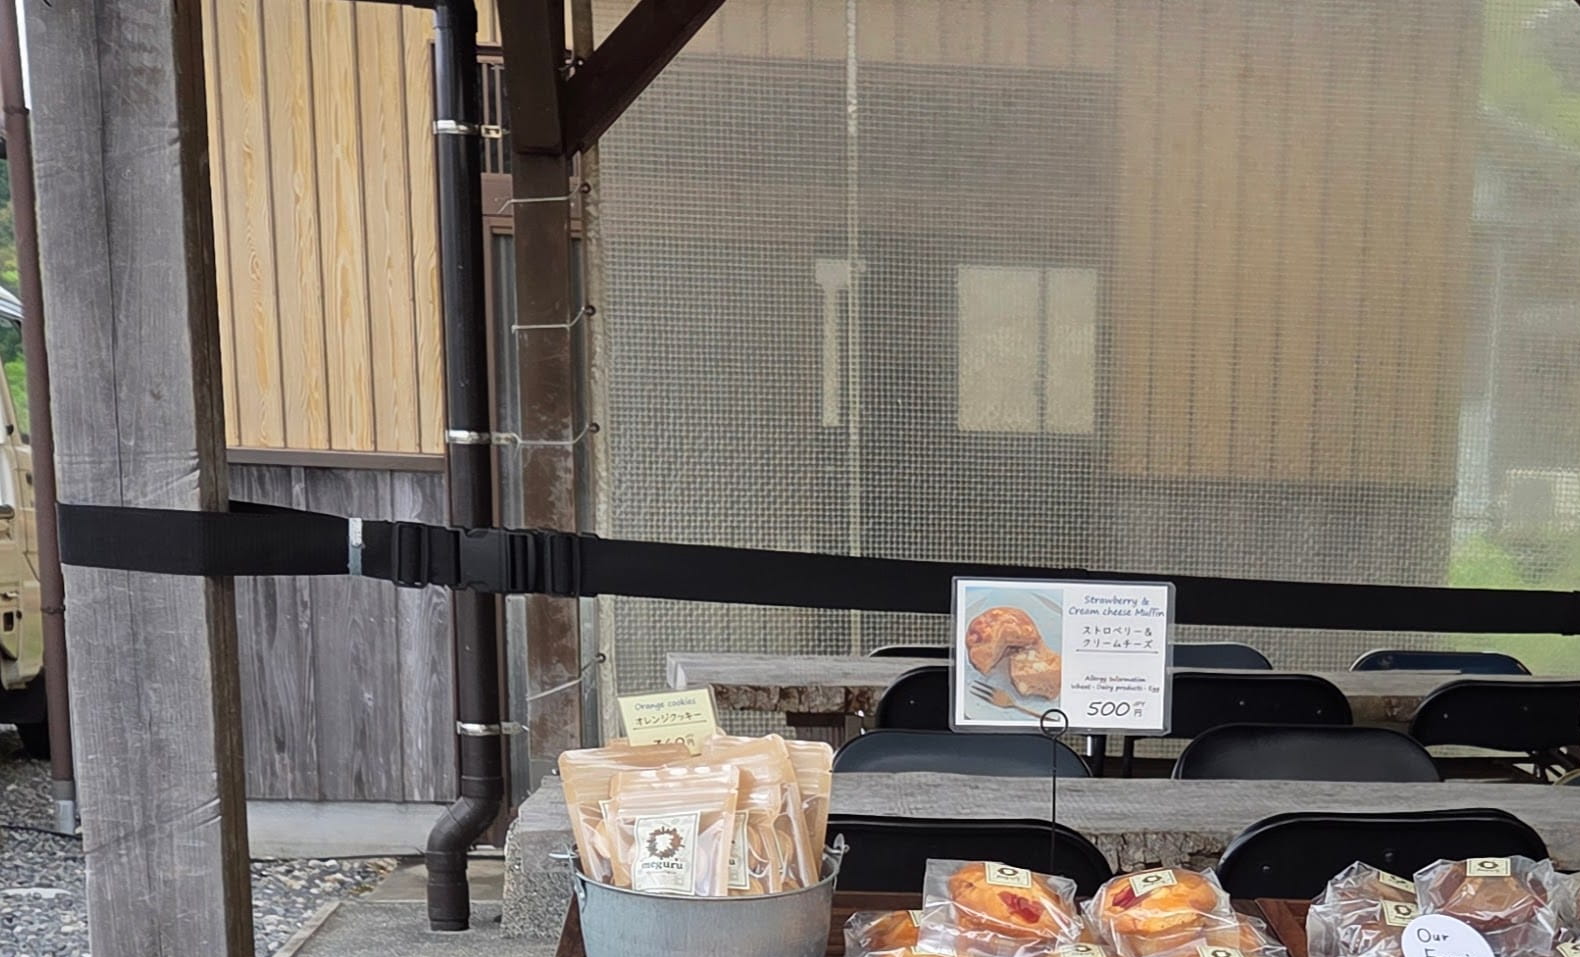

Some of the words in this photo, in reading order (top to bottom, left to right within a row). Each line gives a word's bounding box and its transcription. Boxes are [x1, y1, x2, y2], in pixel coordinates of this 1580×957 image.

[1084, 595, 1138, 607] Strawberry
[1068, 606, 1099, 616] Cream
[1102, 607, 1132, 616] cheese
[1082, 639, 1153, 648] クリームチーズ
[634, 701, 664, 711] Orange
[667, 697, 696, 707] cookies
[1087, 701, 1130, 716] 500
[635, 712, 702, 726] オレンジクッキー
[1417, 928, 1449, 943] Our
